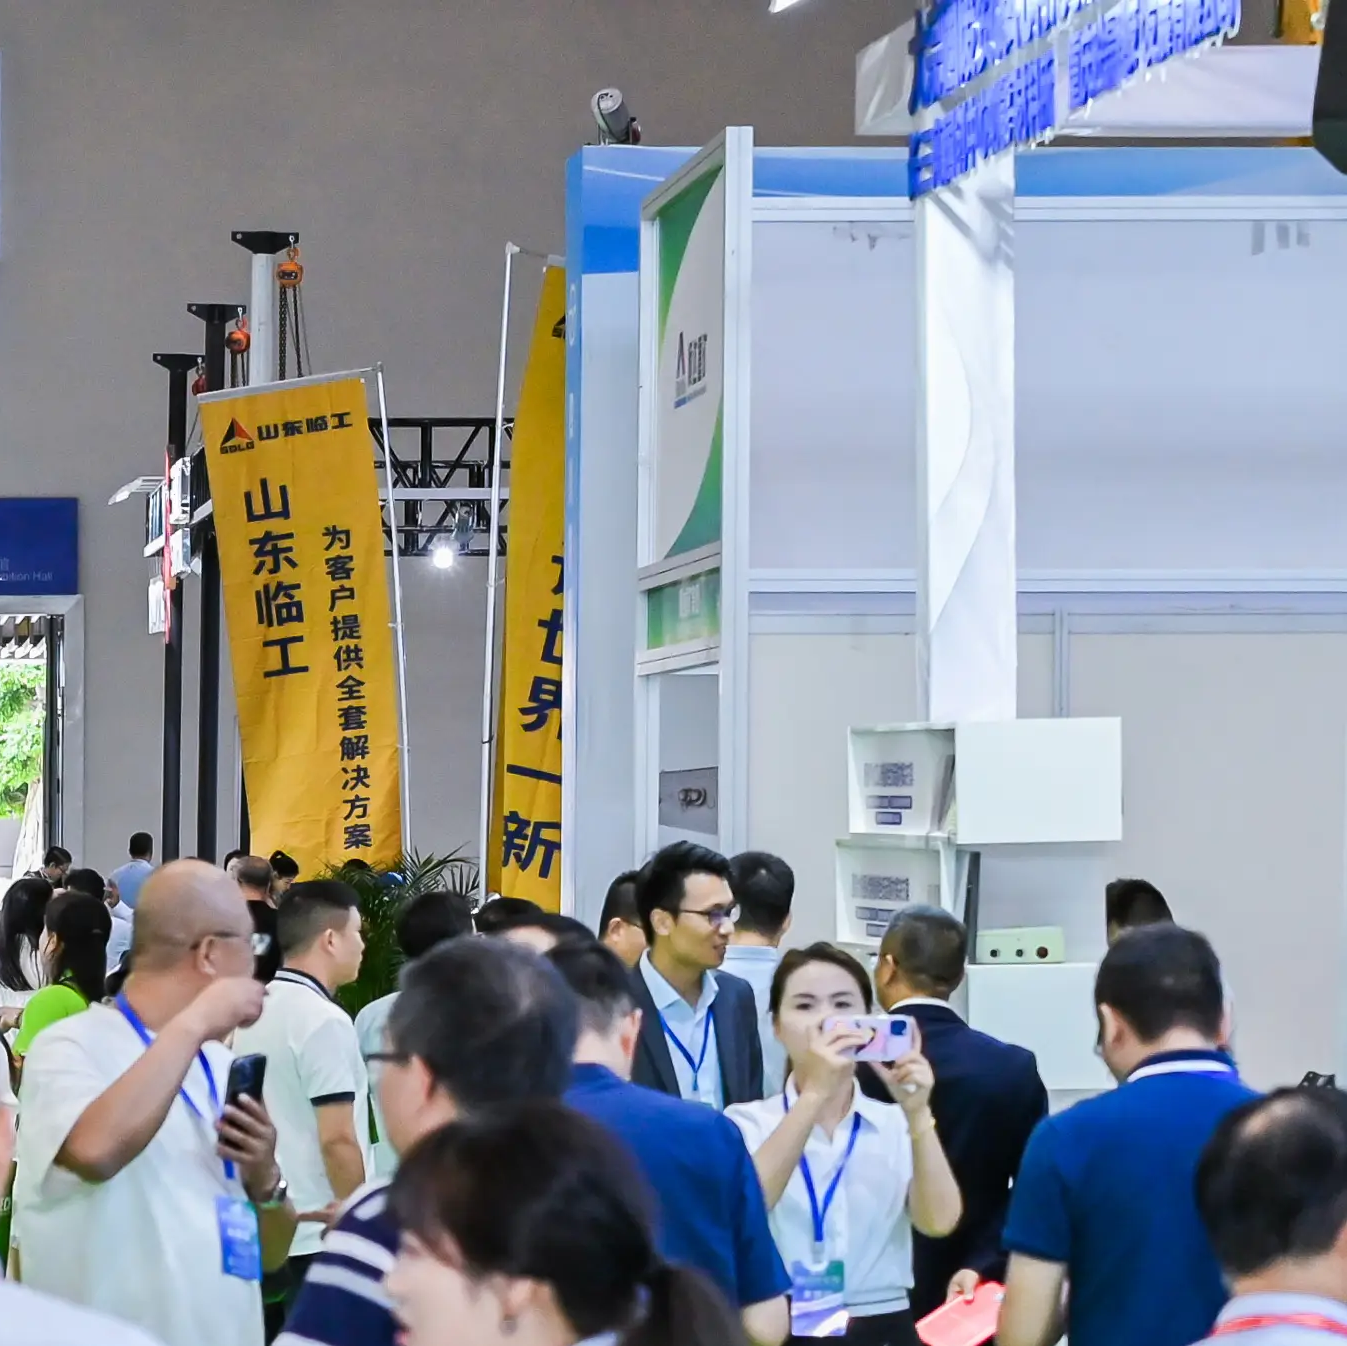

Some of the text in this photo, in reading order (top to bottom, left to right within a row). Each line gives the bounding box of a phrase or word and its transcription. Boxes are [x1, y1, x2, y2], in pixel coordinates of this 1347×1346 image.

[257, 411, 353, 441] 山东临工
[243, 478, 309, 679] 山东临工
[322, 525, 373, 850] 为客户提供全套解决方案
